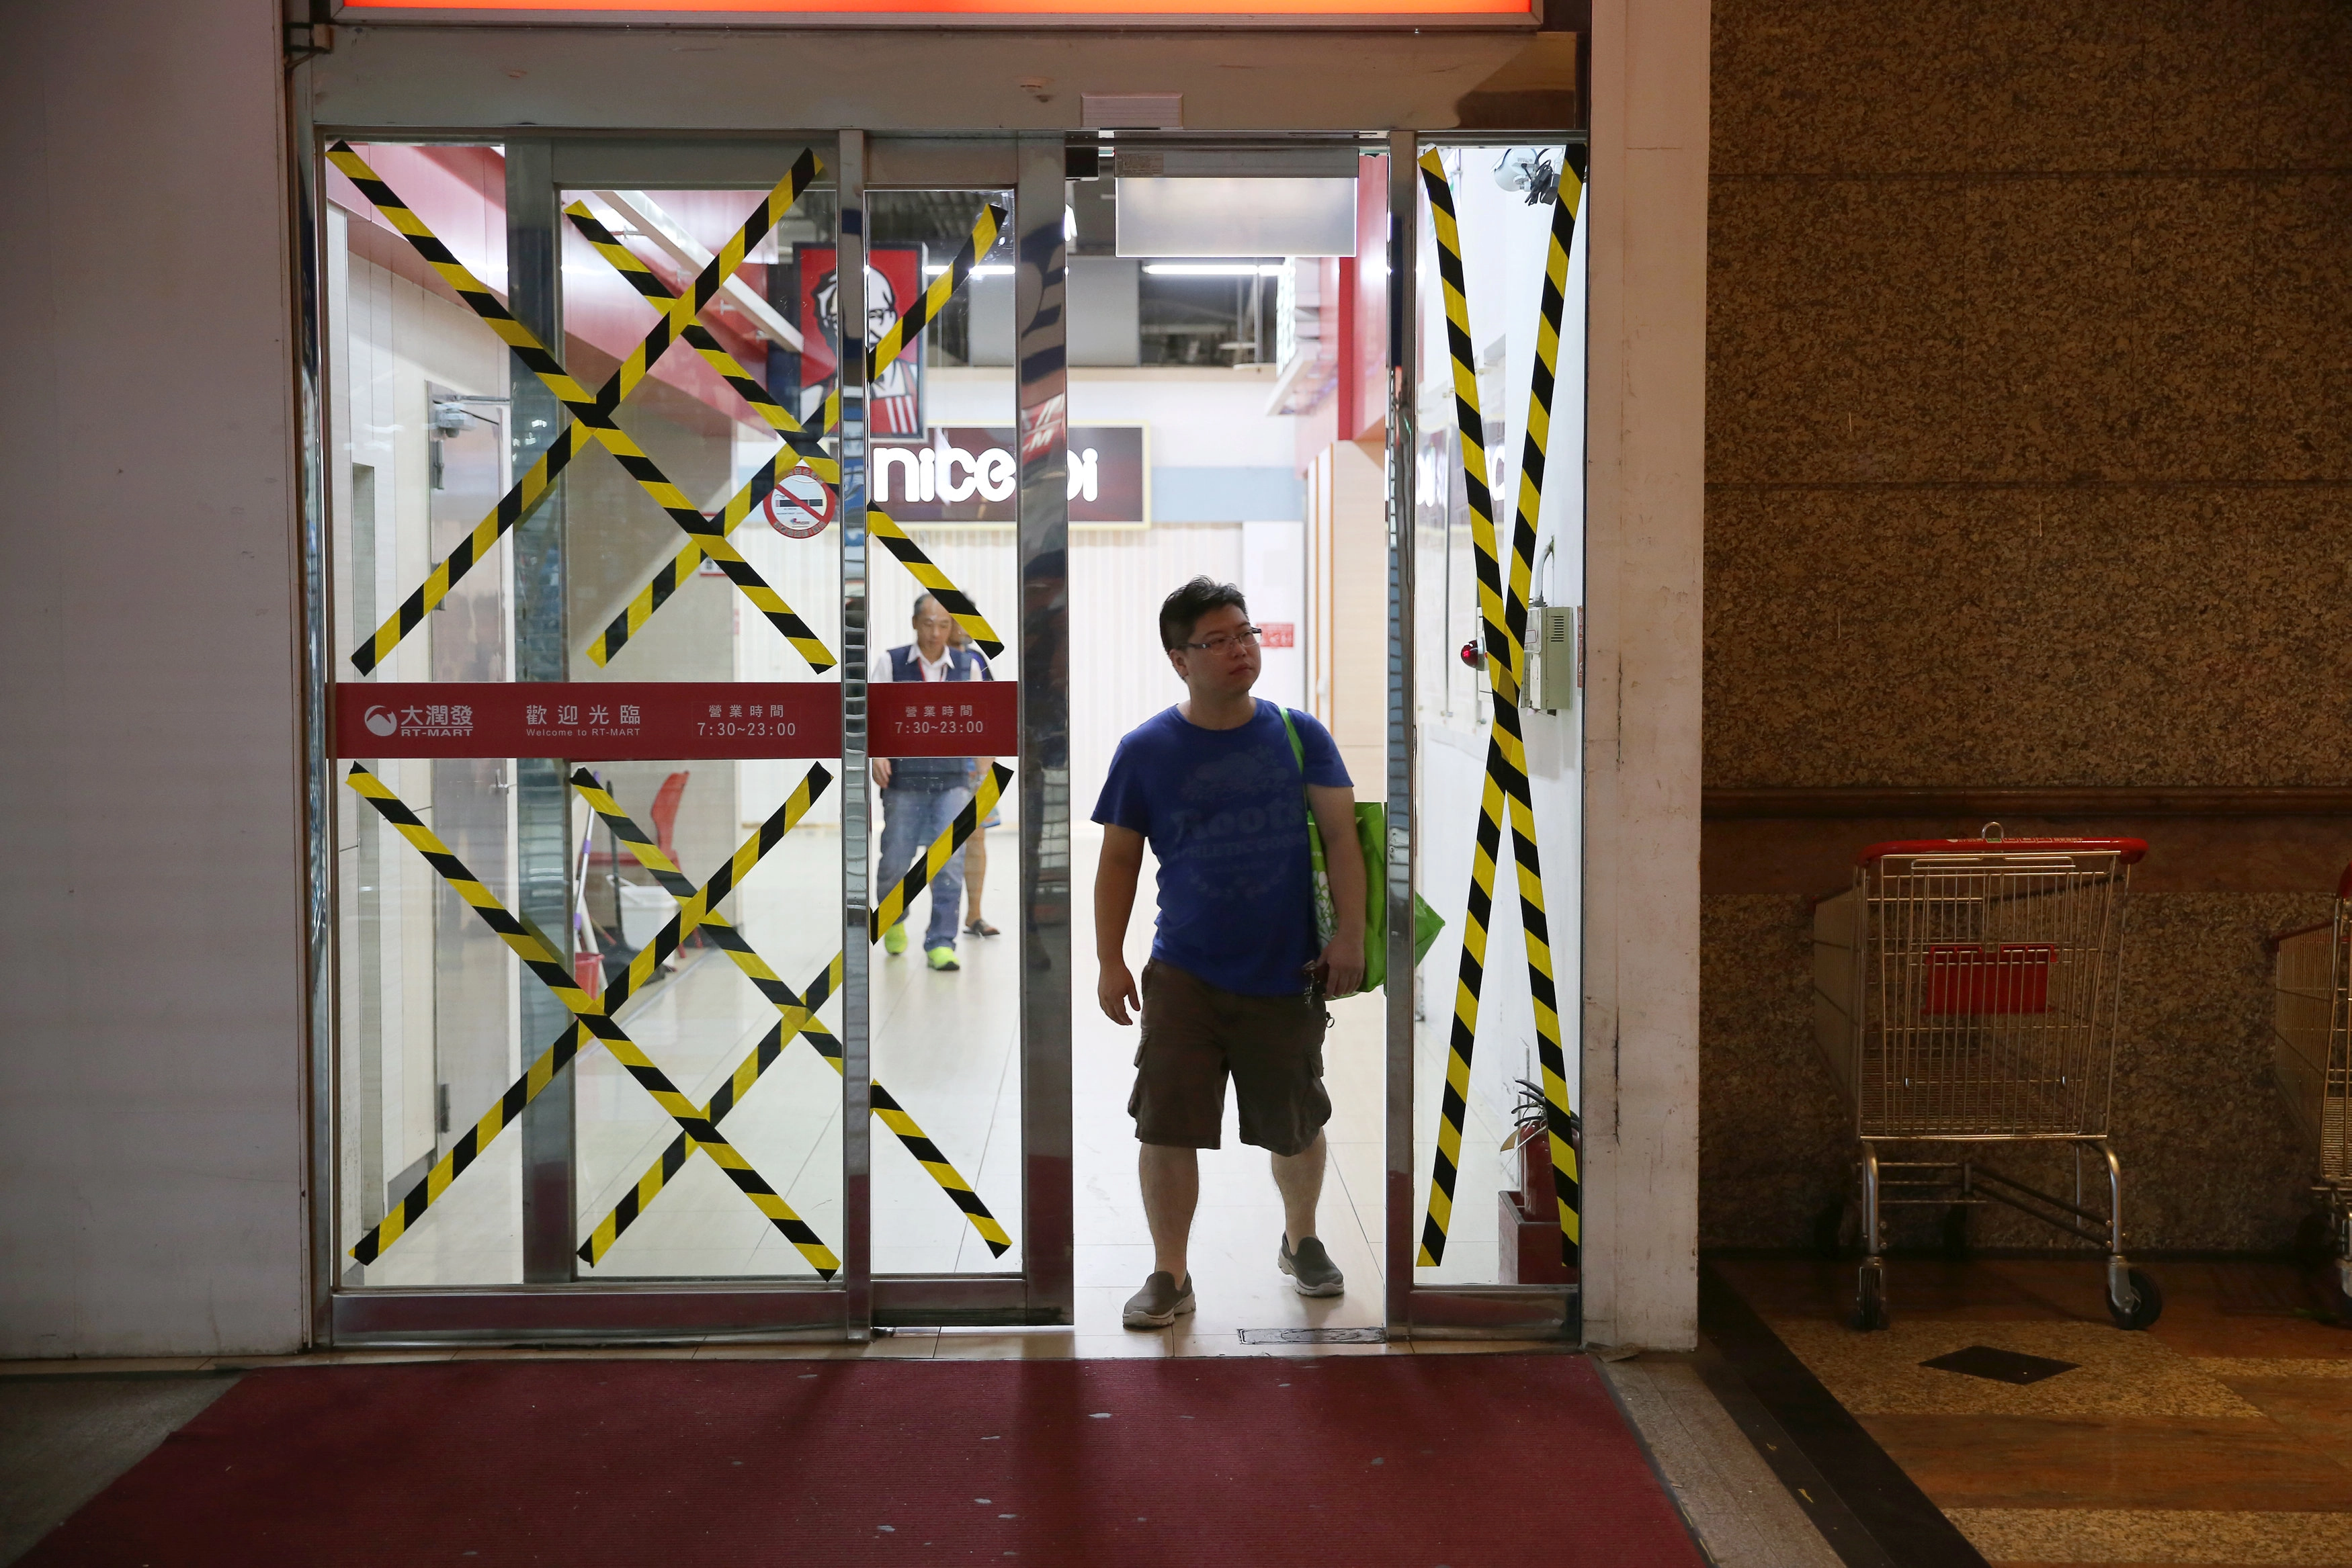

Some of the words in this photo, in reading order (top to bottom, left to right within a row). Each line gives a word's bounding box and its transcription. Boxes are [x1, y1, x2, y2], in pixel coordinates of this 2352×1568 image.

[401, 704, 473, 726] 大潤發
[526, 703, 641, 725] 歡迎光臨
[708, 703, 784, 718] 營業時間
[905, 704, 973, 718] 營業時間
[401, 728, 473, 737] RT-MART
[526, 728, 573, 736] Welcome
[577, 728, 587, 736] to
[591, 728, 641, 736] RT-MART
[696, 722, 796, 736] 7:30~23:00
[894, 720, 984, 734] 7:30~23:00
